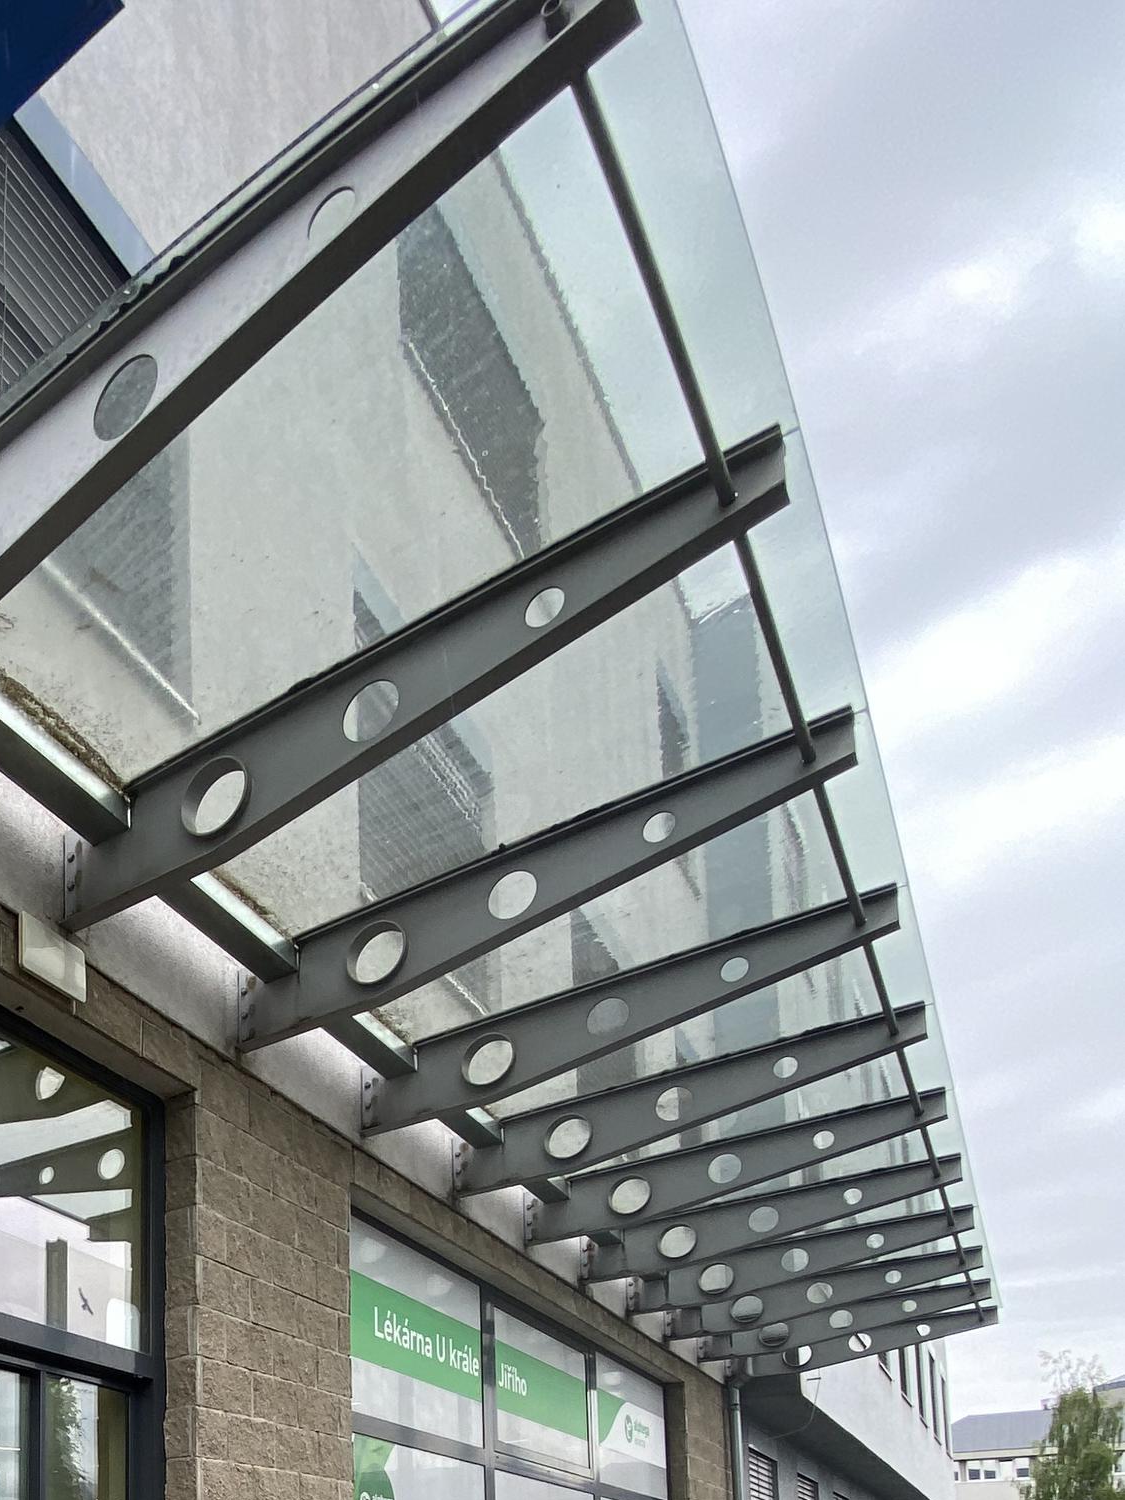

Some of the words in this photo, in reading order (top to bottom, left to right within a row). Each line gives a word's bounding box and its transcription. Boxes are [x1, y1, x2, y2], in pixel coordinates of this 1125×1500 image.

[374, 1306, 433, 1359] Lékárna
[436, 1333, 446, 1363] U
[449, 1338, 480, 1377] krále
[498, 1362, 528, 1397] Jiřího
